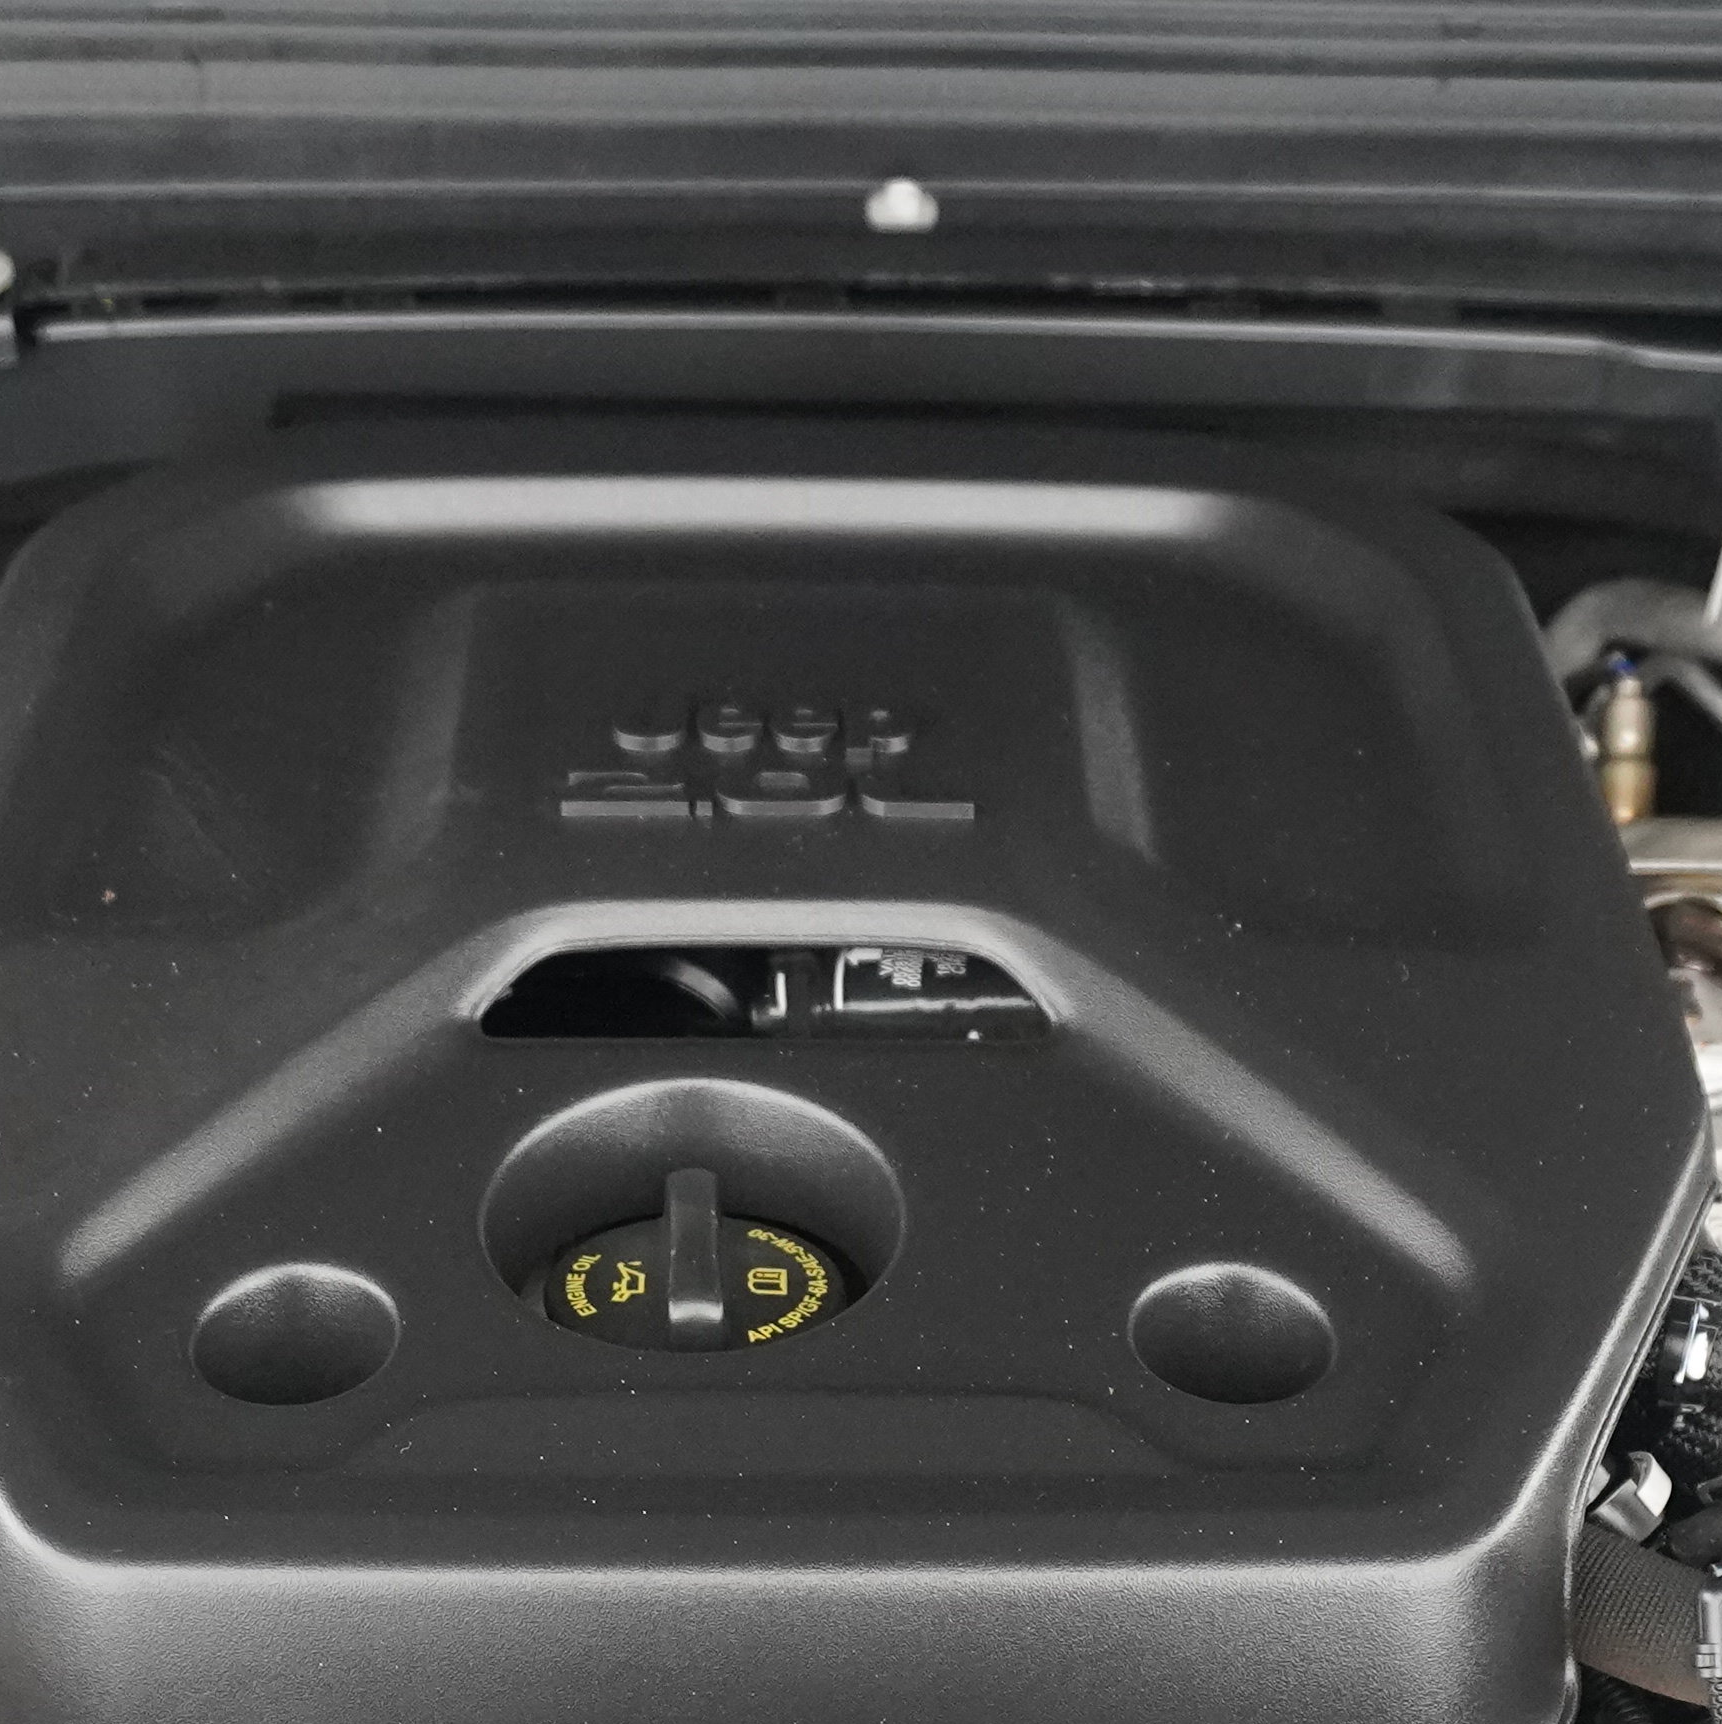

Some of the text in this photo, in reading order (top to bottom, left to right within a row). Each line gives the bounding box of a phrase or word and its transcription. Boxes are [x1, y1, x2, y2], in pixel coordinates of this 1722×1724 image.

[566, 1254, 602, 1317] ENGINE OIL
[748, 1323, 783, 1343] API
